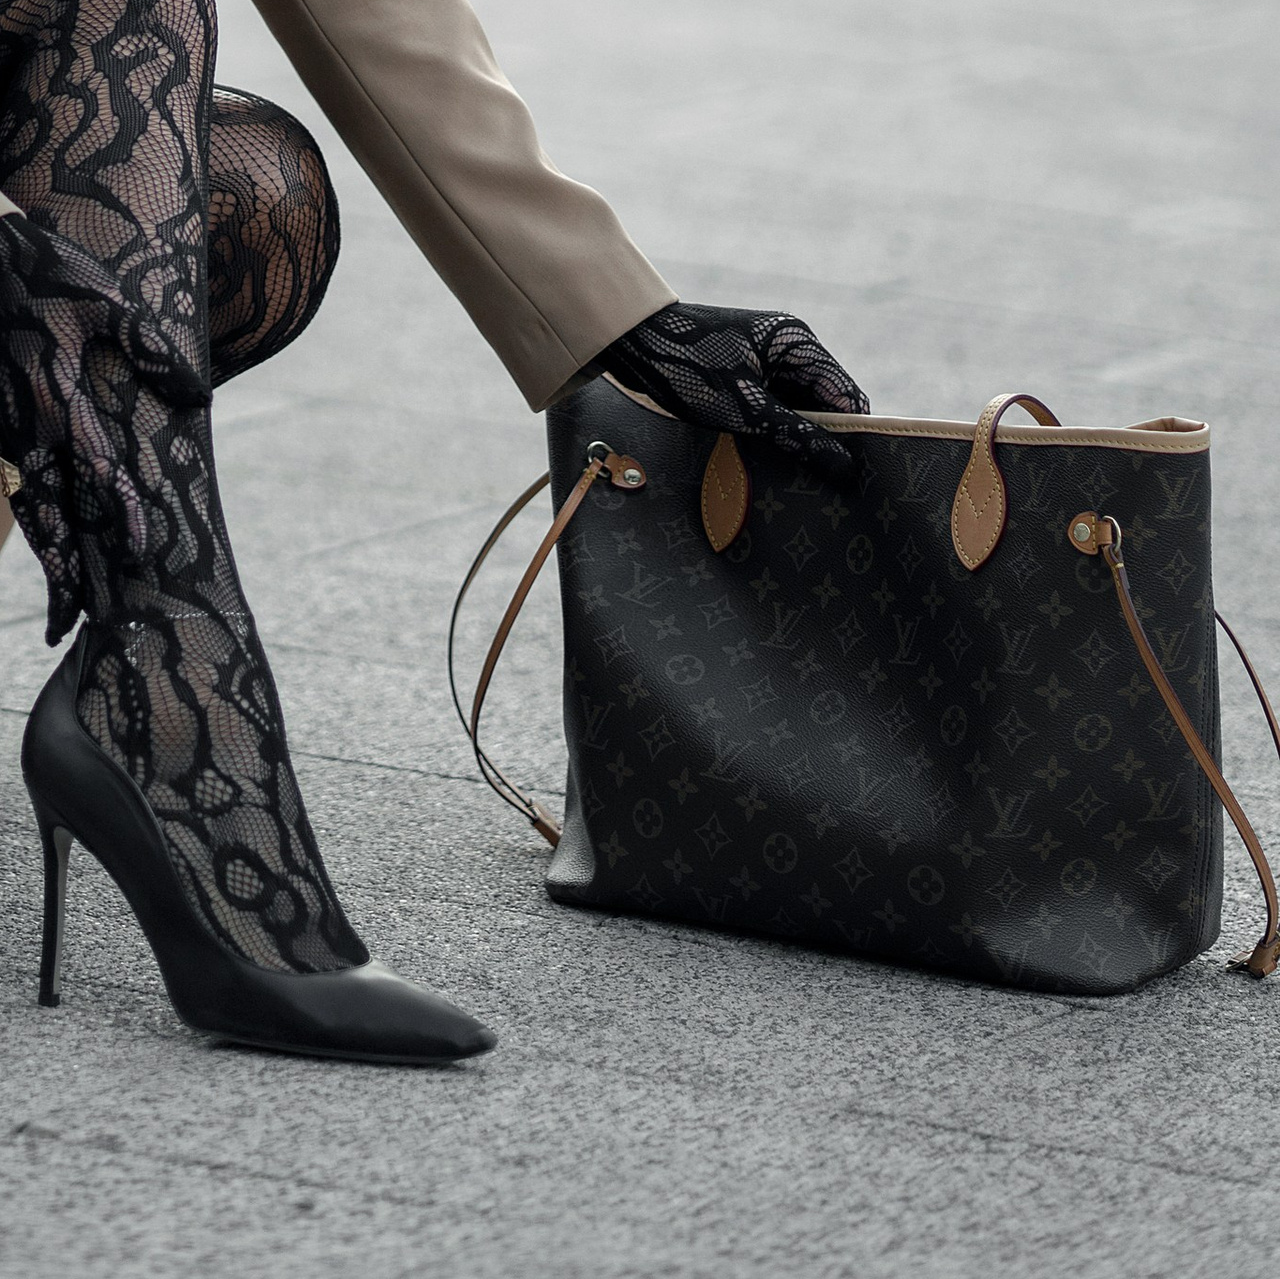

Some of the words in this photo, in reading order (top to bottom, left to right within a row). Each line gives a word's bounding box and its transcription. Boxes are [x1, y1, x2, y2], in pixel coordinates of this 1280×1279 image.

[1154, 469, 1200, 519] LV
[615, 560, 675, 608] LV
[759, 601, 811, 650] LV
[888, 614, 923, 665] LV
[995, 621, 1039, 675] LV
[579, 694, 616, 751] LV
[699, 730, 757, 783] LV
[984, 786, 1038, 839] LV
[1136, 771, 1186, 823] LV
